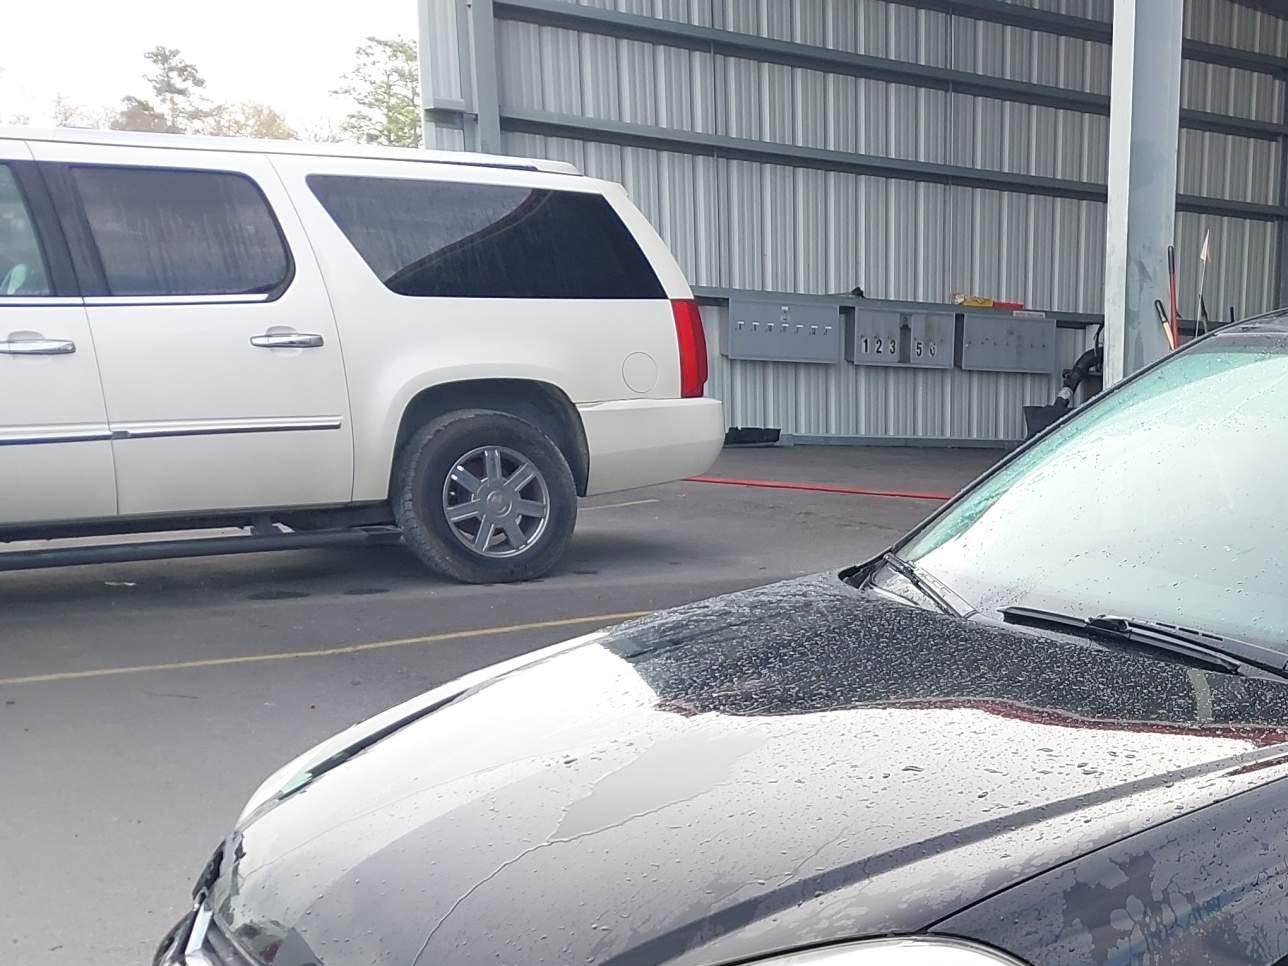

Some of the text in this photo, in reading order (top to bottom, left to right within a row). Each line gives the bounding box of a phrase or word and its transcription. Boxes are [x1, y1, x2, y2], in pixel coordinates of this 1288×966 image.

[863, 338, 869, 353] 1
[875, 339, 882, 354] 2
[889, 339, 896, 354] 3
[916, 341, 923, 357] 5
